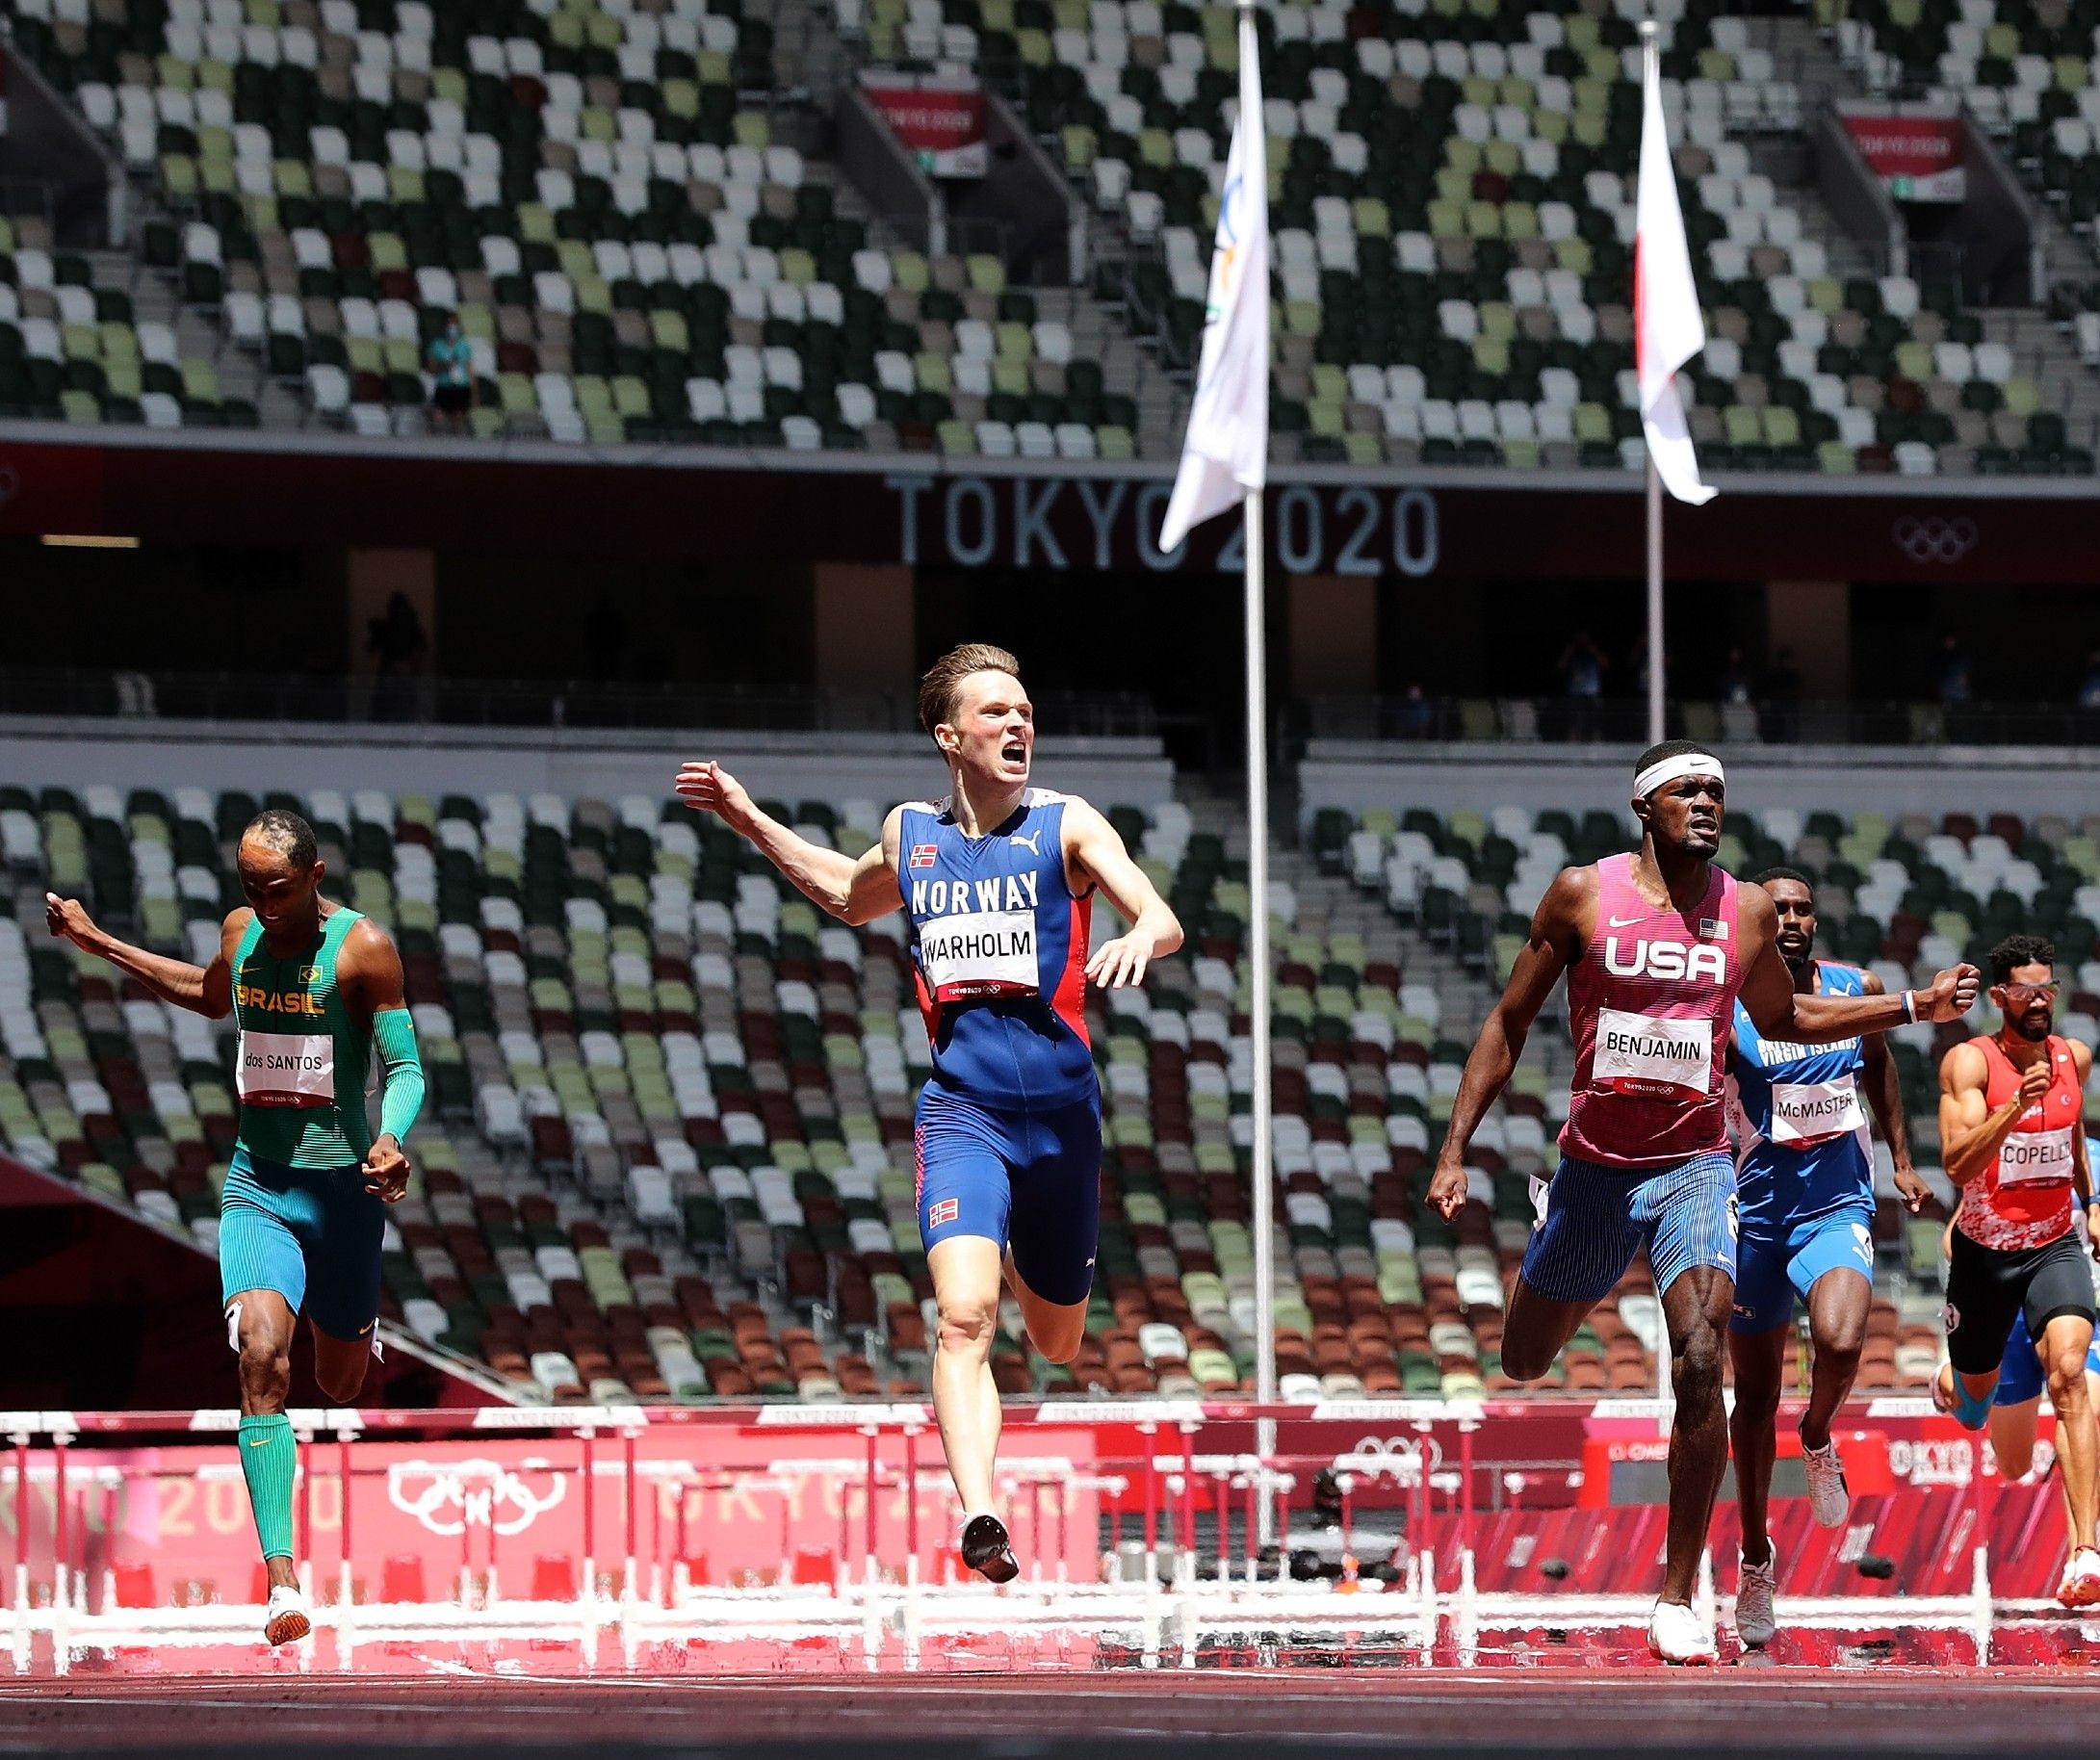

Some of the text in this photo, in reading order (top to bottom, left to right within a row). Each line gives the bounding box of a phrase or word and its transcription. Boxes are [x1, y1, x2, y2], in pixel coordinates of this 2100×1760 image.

[885, 474, 1188, 571] TOKYO
[912, 870, 1039, 915] NORWAY
[924, 931, 1031, 964] WARHOLM
[1605, 936, 1726, 985] USA
[236, 985, 325, 1015] BRASIL
[1606, 1031, 1701, 1060] BENJAMIN
[1760, 1037, 1857, 1067] VIRGIN ISLANDS
[245, 1052, 323, 1071] dos SANTOS
[1778, 1093, 1854, 1118] McMASTER
[157, 1477, 341, 1536] 200
